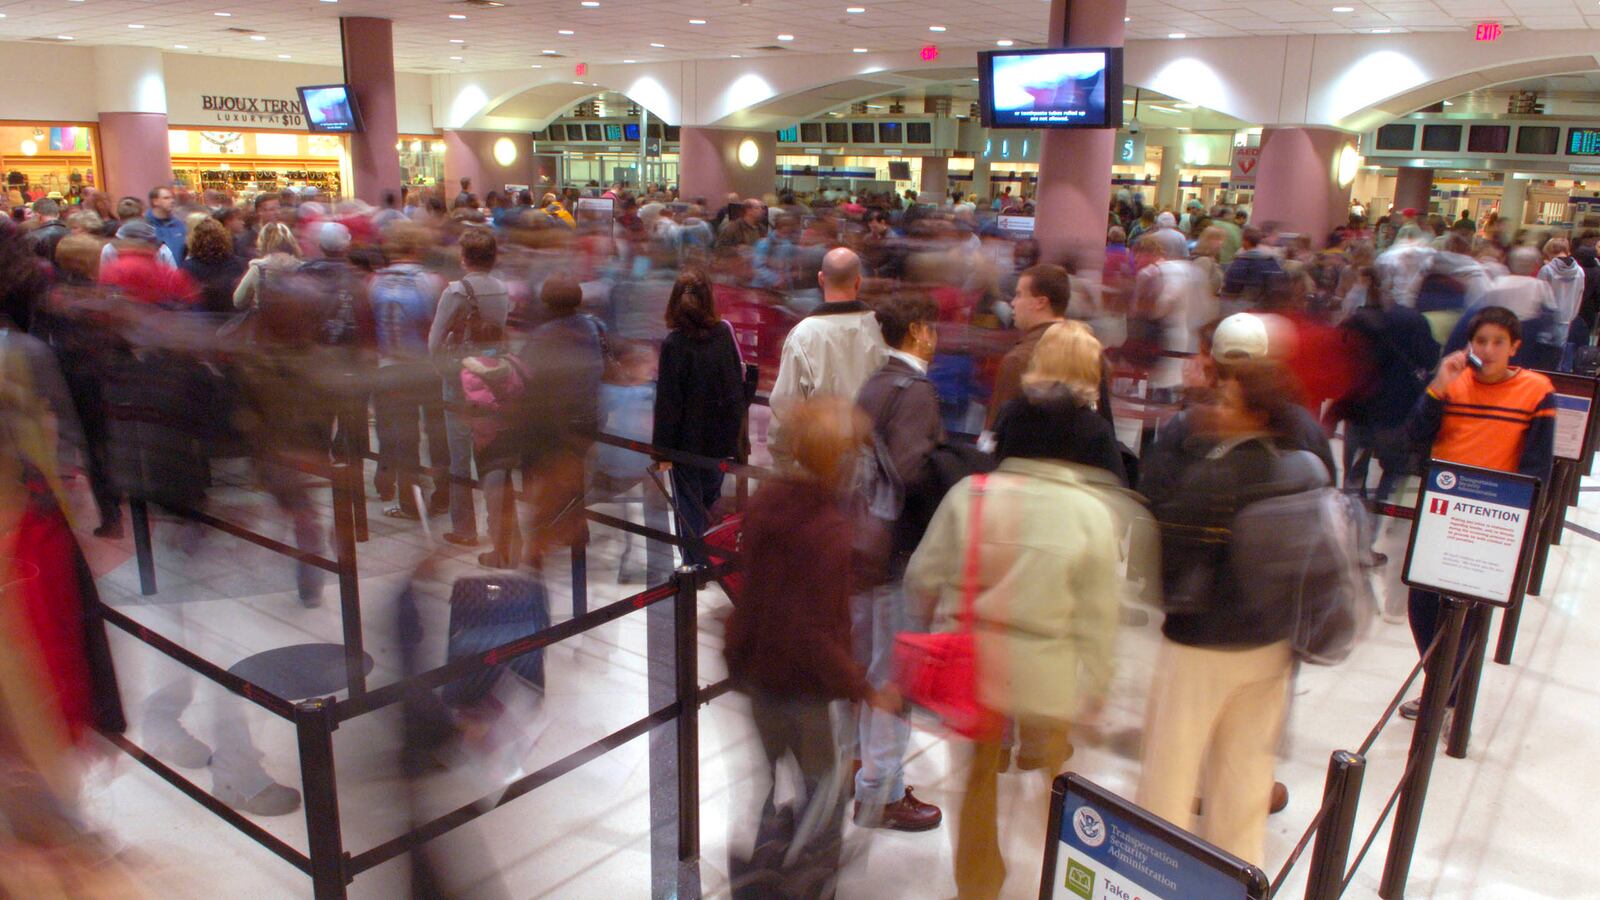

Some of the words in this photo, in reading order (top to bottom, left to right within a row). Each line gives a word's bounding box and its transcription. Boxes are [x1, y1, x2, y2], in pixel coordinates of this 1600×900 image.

[1476, 24, 1498, 40] EXIT
[202, 95, 258, 112] BIJOUX
[261, 99, 303, 115] TERN
[217, 113, 263, 122] LUXURY
[269, 115, 279, 123] AT
[282, 114, 301, 126] $10
[1453, 502, 1520, 523] ATTENTION
[1110, 834, 1148, 863] Security
[1111, 824, 1178, 868] Transportation
[1107, 845, 1177, 890] Administration
[1104, 878, 1130, 900] Take
